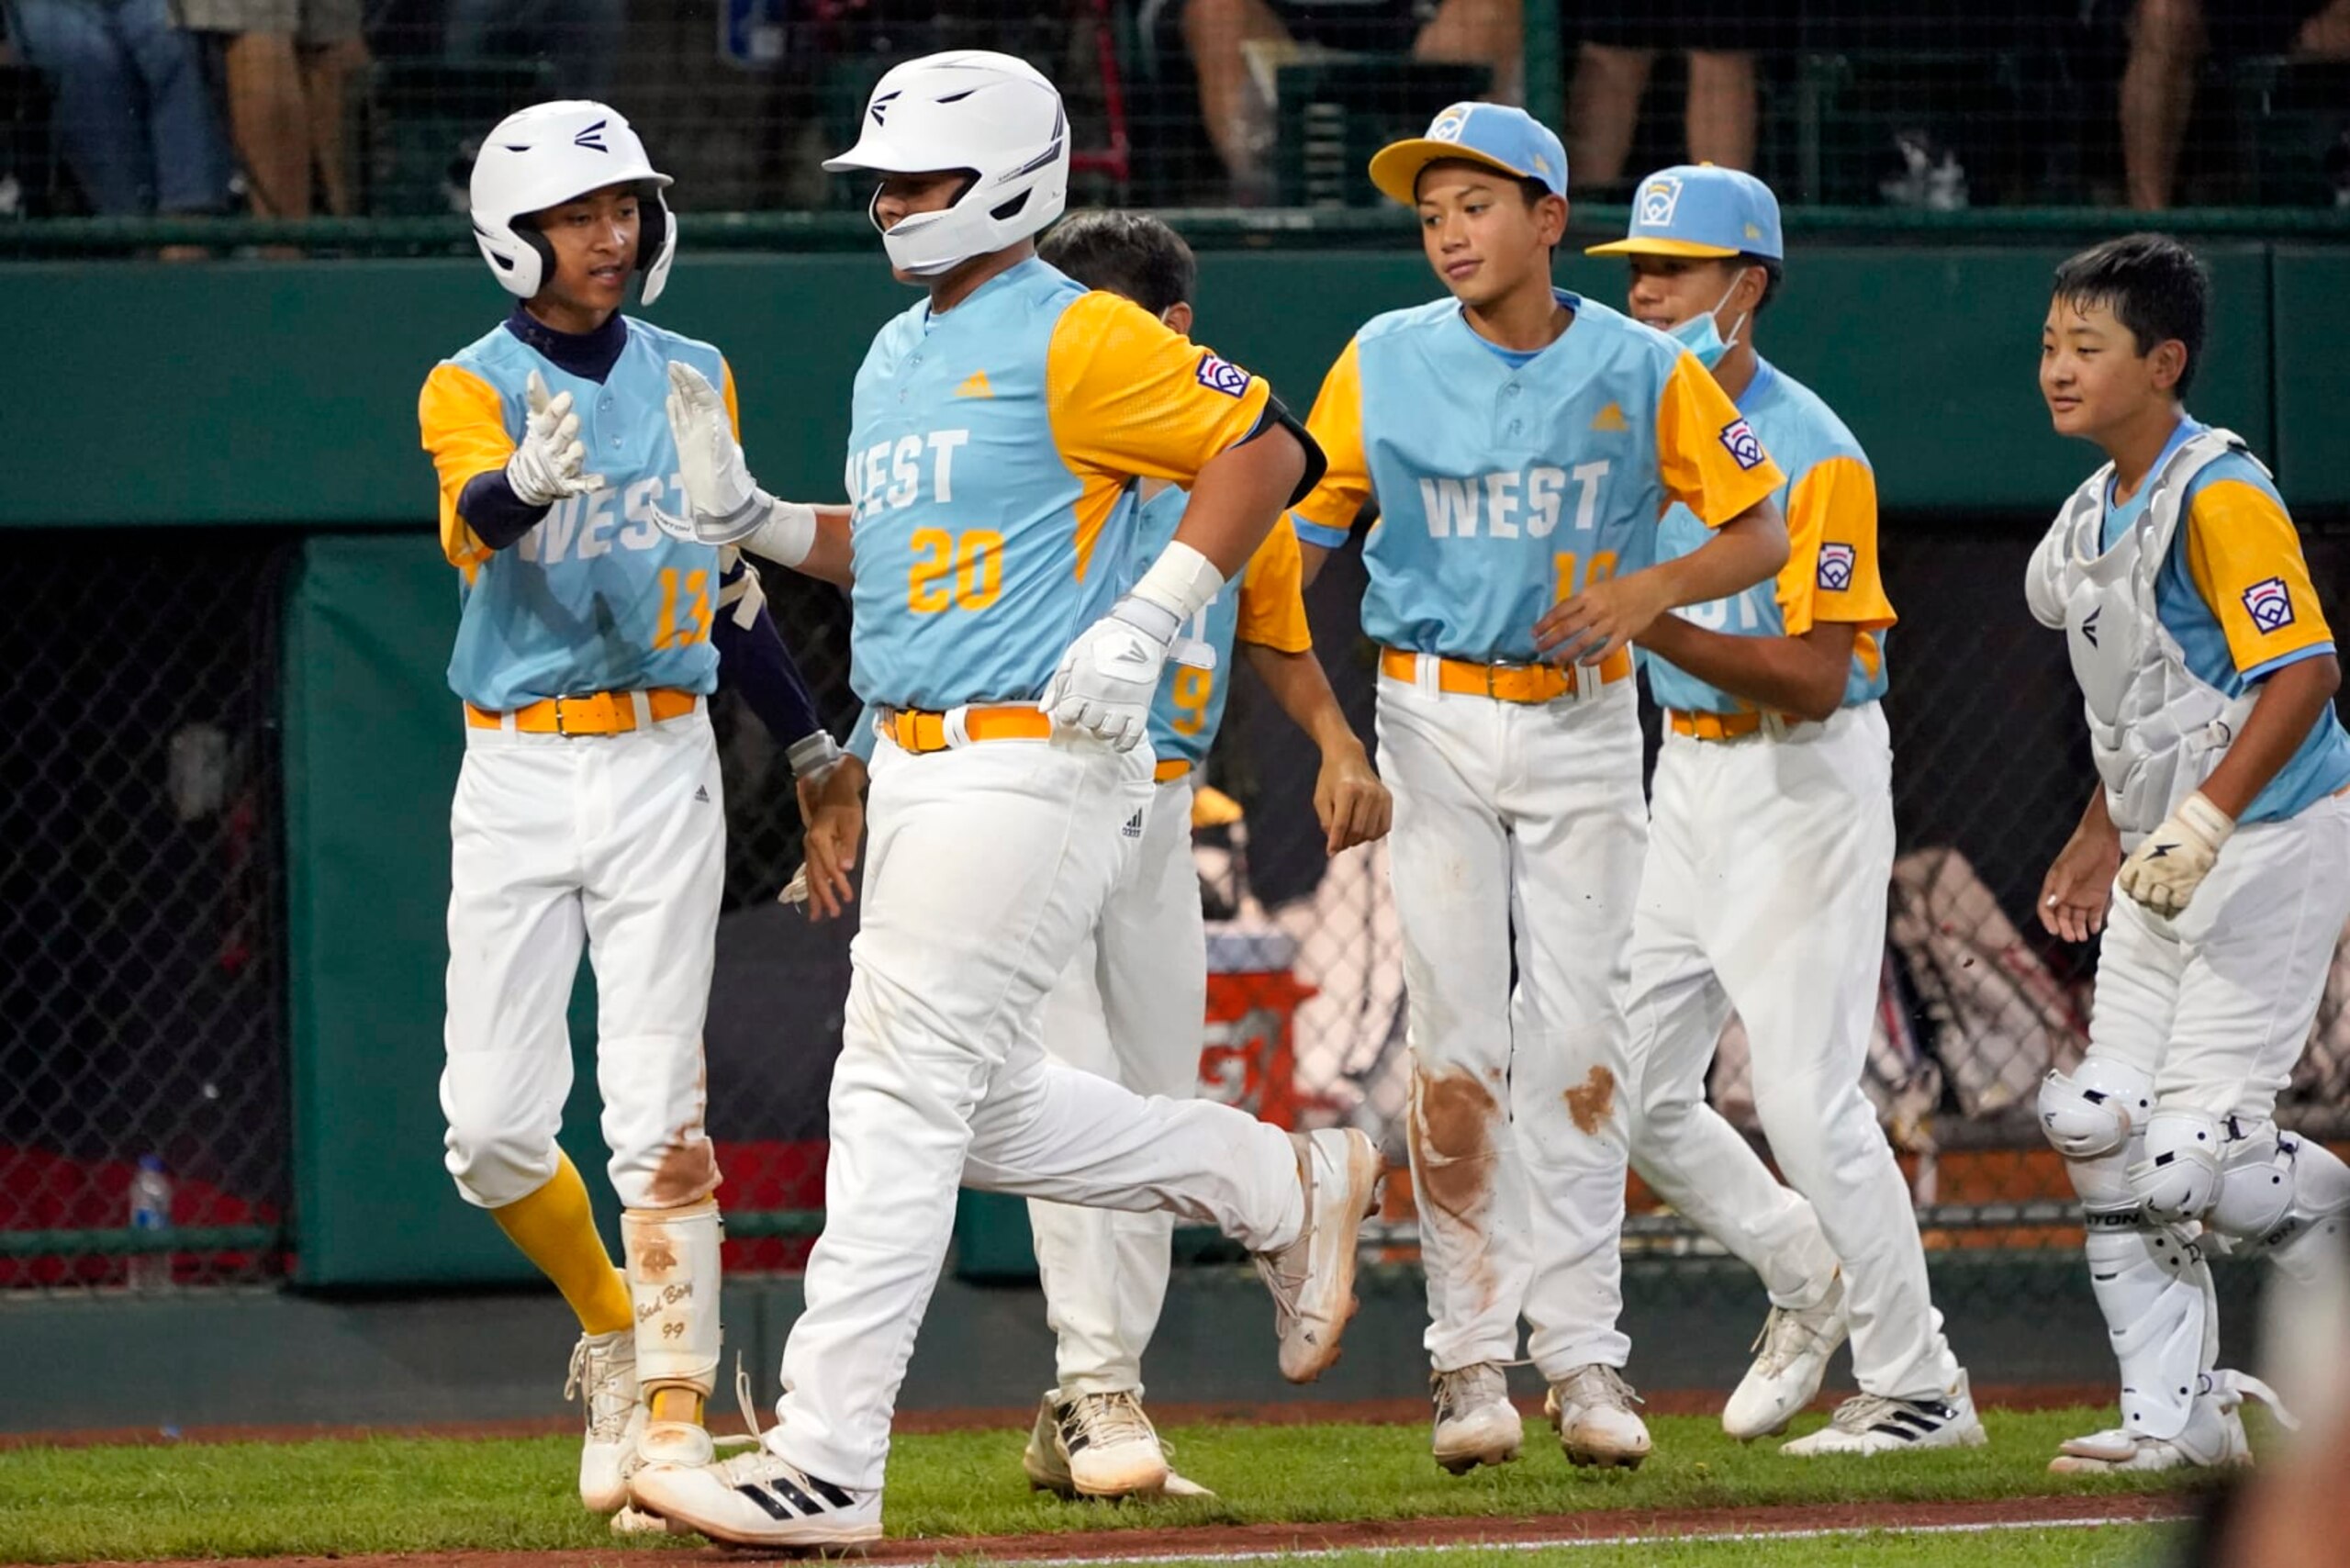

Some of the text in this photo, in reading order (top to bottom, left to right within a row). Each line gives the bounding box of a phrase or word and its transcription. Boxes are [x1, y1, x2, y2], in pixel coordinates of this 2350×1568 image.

[1418, 458, 1610, 539] WEST
[652, 566, 712, 650] 13
[907, 527, 1005, 614] 20
[662, 1322, 685, 1339] 99
